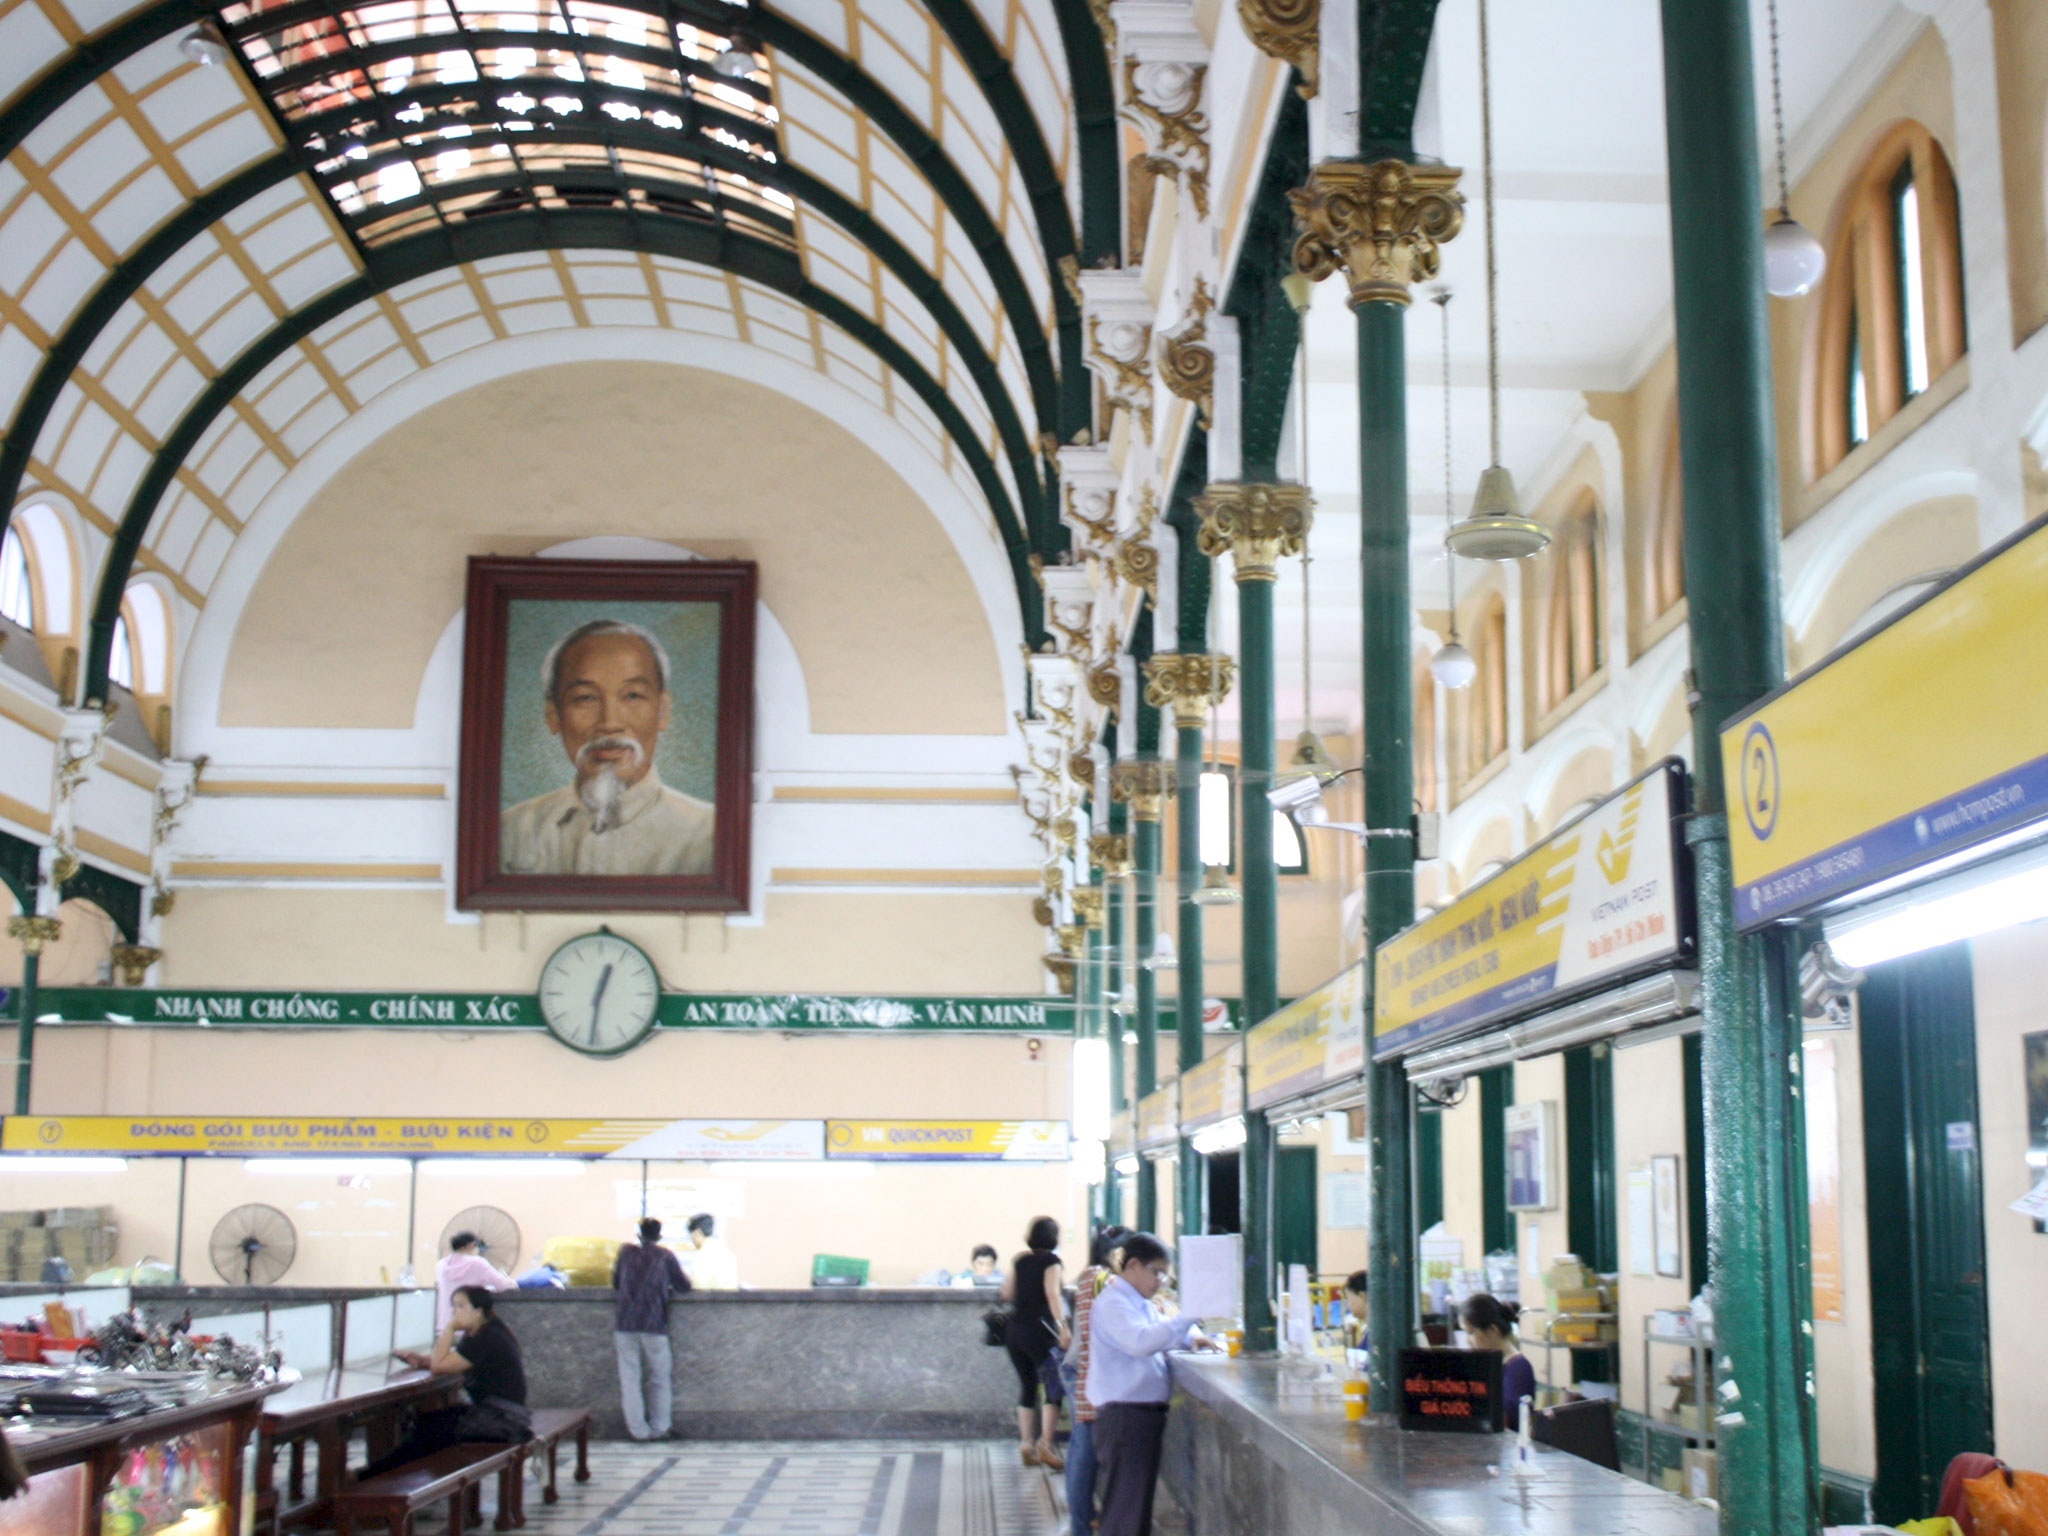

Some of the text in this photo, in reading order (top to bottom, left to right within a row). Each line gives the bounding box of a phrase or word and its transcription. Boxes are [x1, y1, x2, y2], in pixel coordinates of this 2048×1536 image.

[1752, 746, 1769, 813] 2
[1631, 880, 1658, 903] POST
[155, 996, 243, 1019] NHANH
[250, 993, 340, 1020] CHÓNG
[369, 994, 456, 1020] CHÍNH
[465, 995, 519, 1022] XÁC
[683, 1001, 718, 1024] AN
[720, 994, 788, 1025] TOÀN
[925, 1000, 978, 1024] VĂN
[981, 1003, 1046, 1025] MINH
[131, 1121, 195, 1137] ĐÓNG
[203, 1120, 243, 1138] GÓI
[252, 1121, 299, 1138] BƯU
[308, 1116, 376, 1137] PHẨM
[401, 1121, 449, 1138] BƯU
[458, 1121, 514, 1140] KIỆN
[888, 1128, 975, 1144] QUICKPOST
